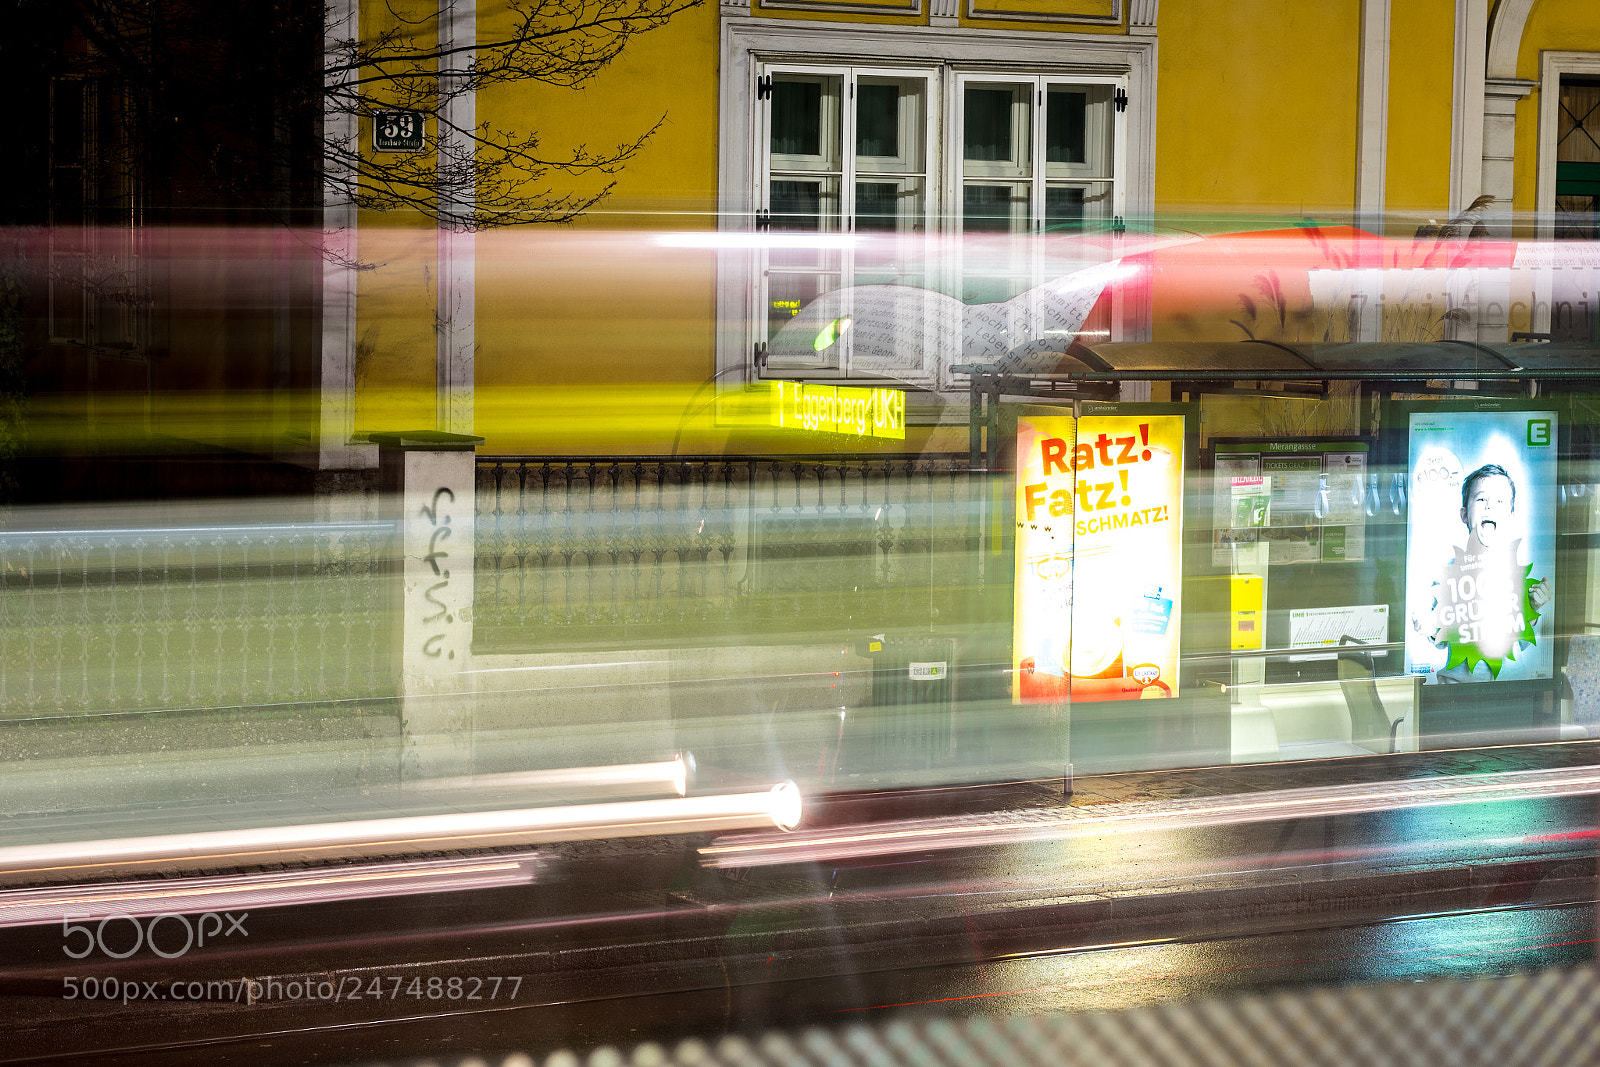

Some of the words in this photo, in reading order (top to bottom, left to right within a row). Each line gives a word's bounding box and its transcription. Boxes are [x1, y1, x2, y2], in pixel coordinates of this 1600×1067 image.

[383, 115, 414, 138] 59
[777, 380, 784, 427] 1
[1041, 423, 1152, 477] Ratz!
[1025, 470, 1131, 521] Fatz!
[1076, 505, 1169, 536] SCHMATZ!
